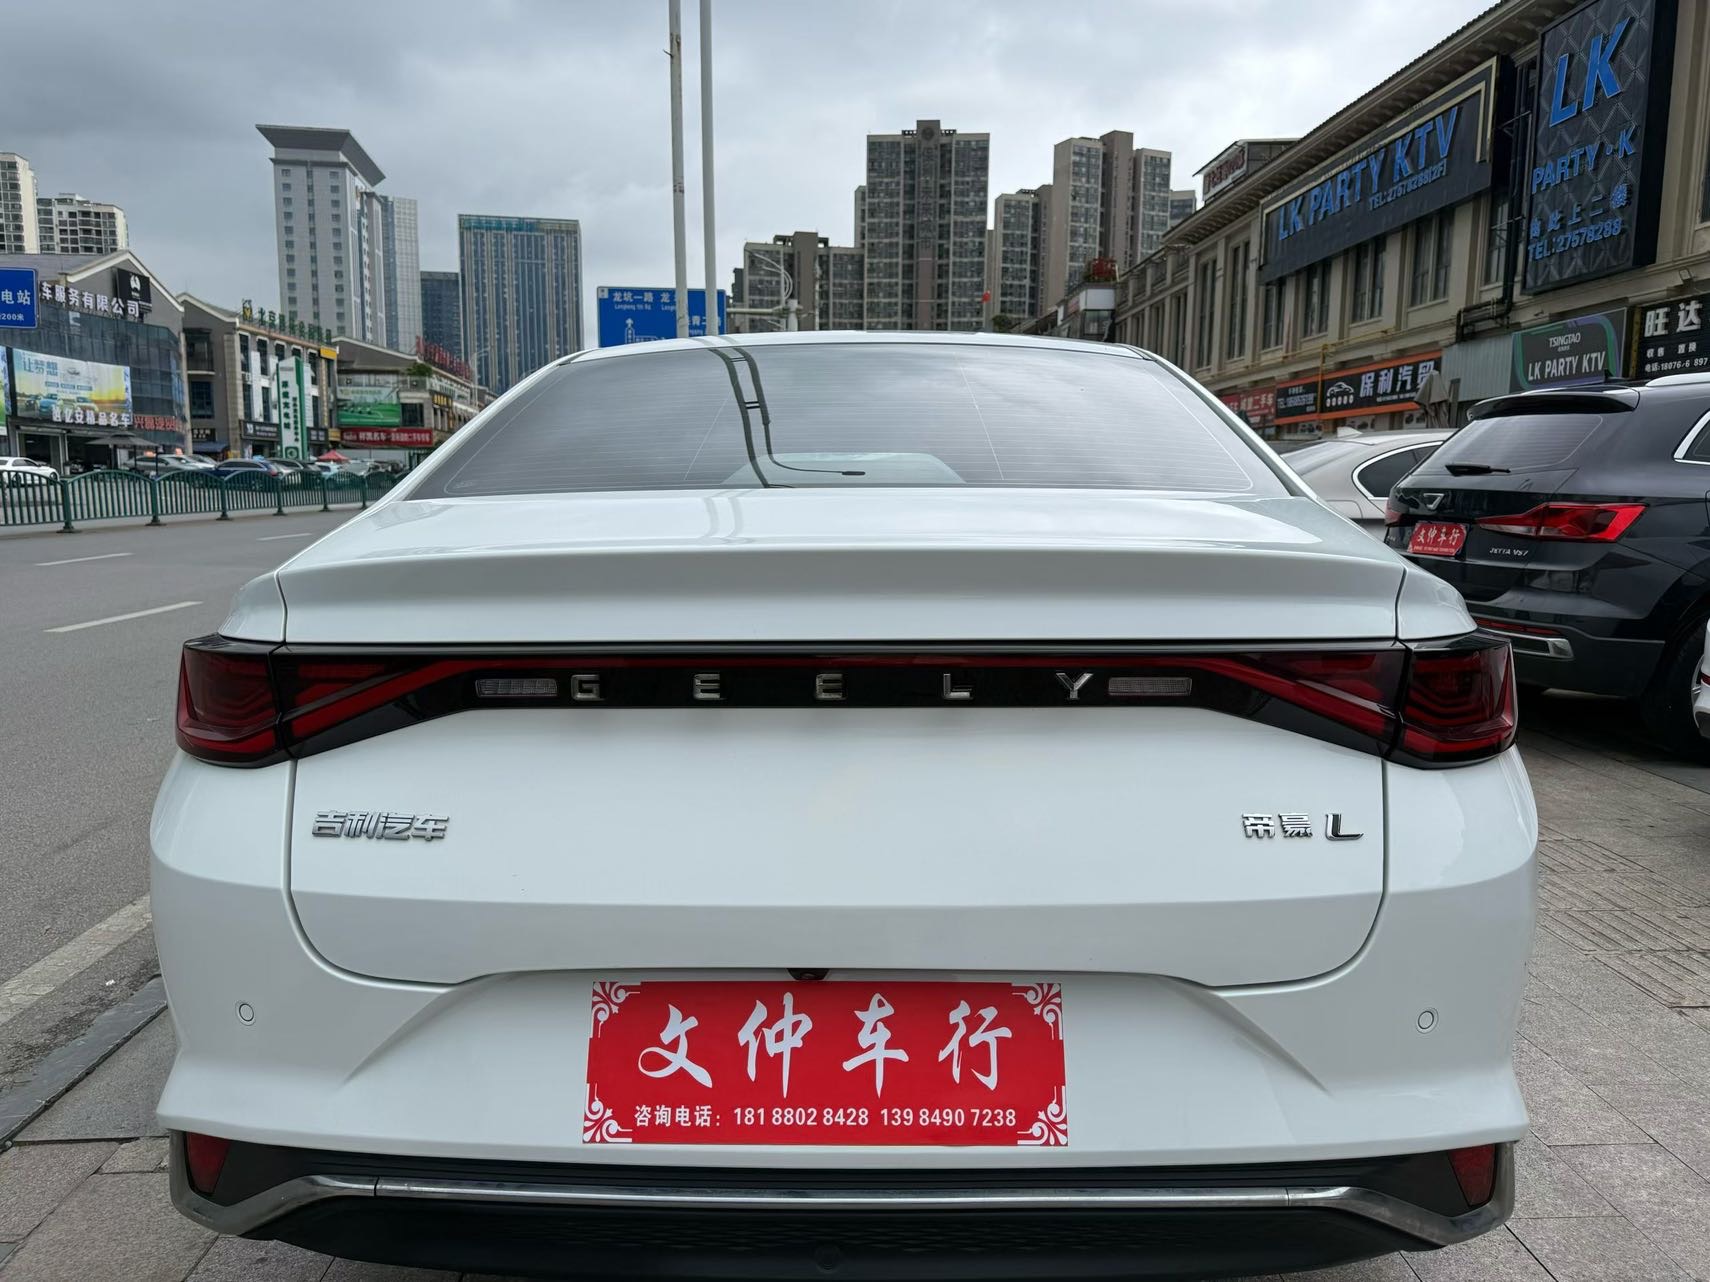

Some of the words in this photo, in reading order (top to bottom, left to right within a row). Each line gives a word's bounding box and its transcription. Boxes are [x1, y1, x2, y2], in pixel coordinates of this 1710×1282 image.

[1550, 16, 1632, 128] LK
[1278, 195, 1305, 241] LK
[1308, 148, 1386, 226] PARTY
[1393, 106, 1460, 183] KTV
[1, 289, 31, 305] 电站
[1644, 299, 1703, 338] 旺达
[1549, 332, 1581, 348] TSINGTAO
[1528, 358, 1541, 382] LK
[1544, 353, 1580, 378] PARTY
[1581, 351, 1606, 374] KTV
[571, 672, 1094, 700] GEELY
[312, 810, 449, 841] 吉利汽车
[1325, 813, 1365, 841] L
[638, 991, 1013, 1099] 文仲车行
[734, 1108, 765, 1126] 181
[772, 1109, 818, 1126] 8802
[823, 1109, 869, 1126] 8428
[881, 1109, 914, 1126] 139
[918, 1109, 965, 1126] 8490
[970, 1109, 1017, 1127] 7238
